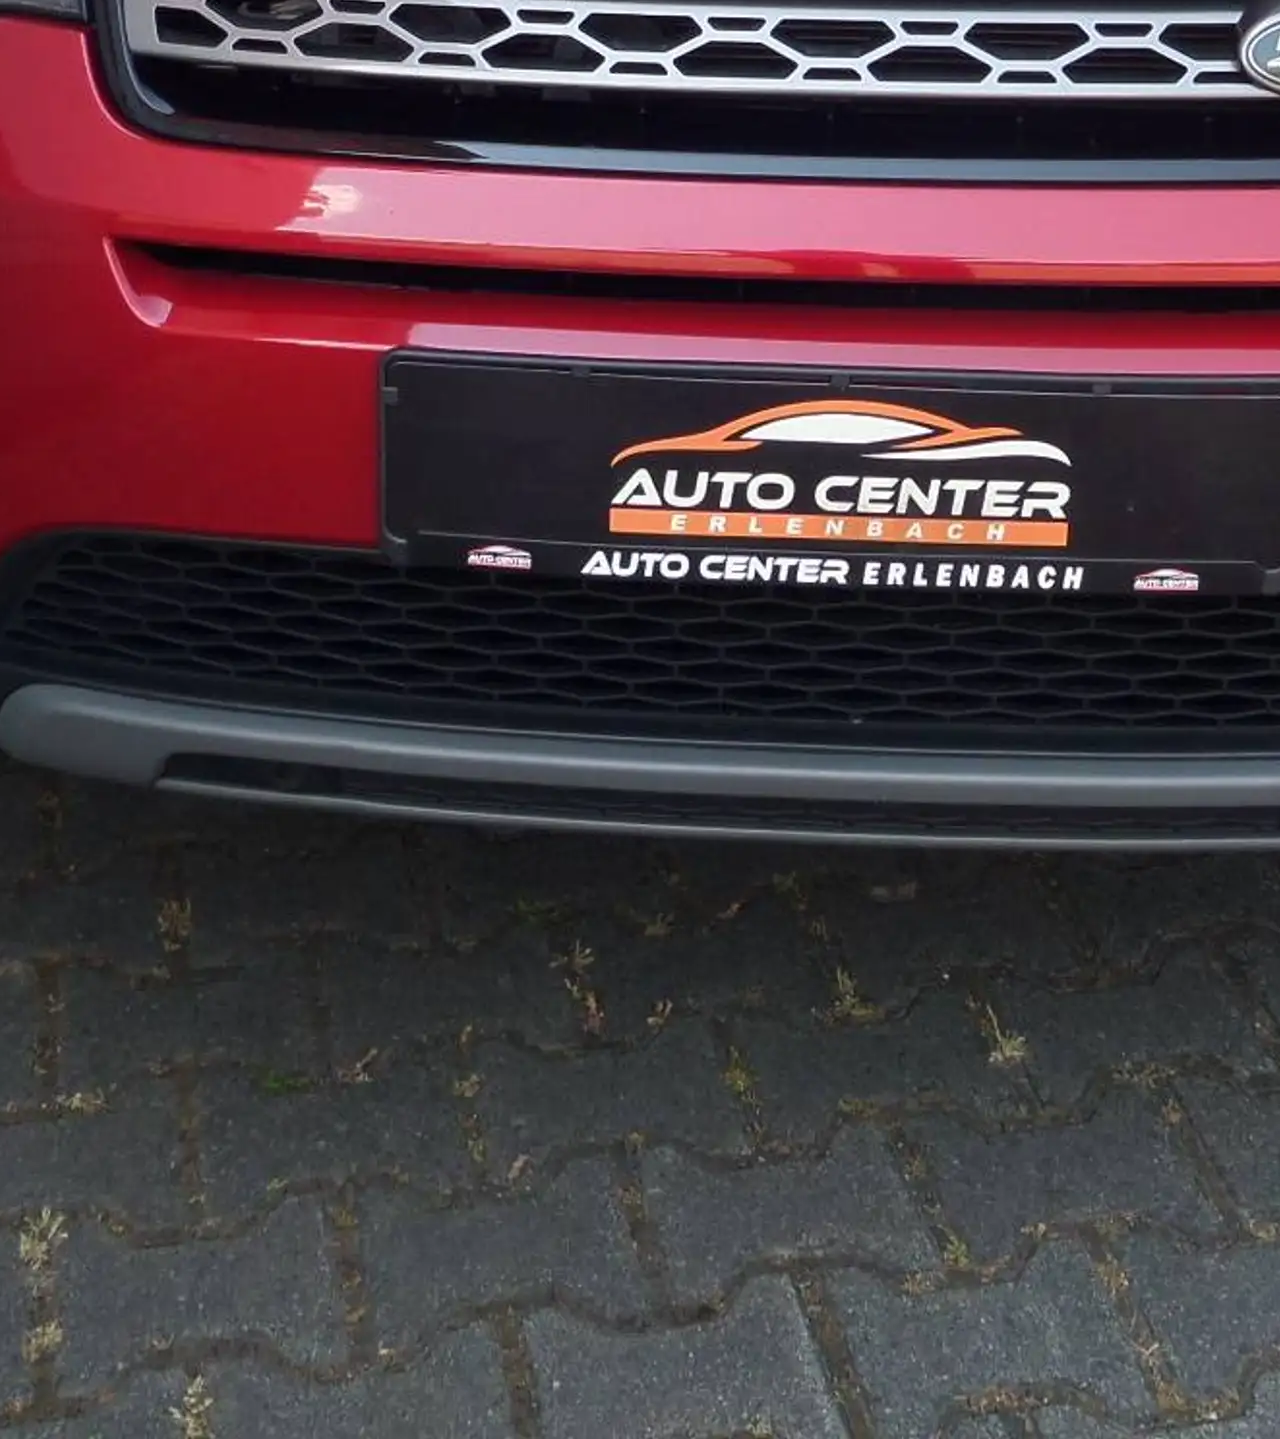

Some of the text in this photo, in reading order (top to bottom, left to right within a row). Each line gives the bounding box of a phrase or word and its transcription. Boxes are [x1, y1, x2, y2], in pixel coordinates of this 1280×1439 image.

[611, 467, 1071, 519] AUTO CENTER
[671, 513, 1005, 542] ERLENBACH
[580, 550, 1084, 590] AUTO CENTER ERLENBACH
